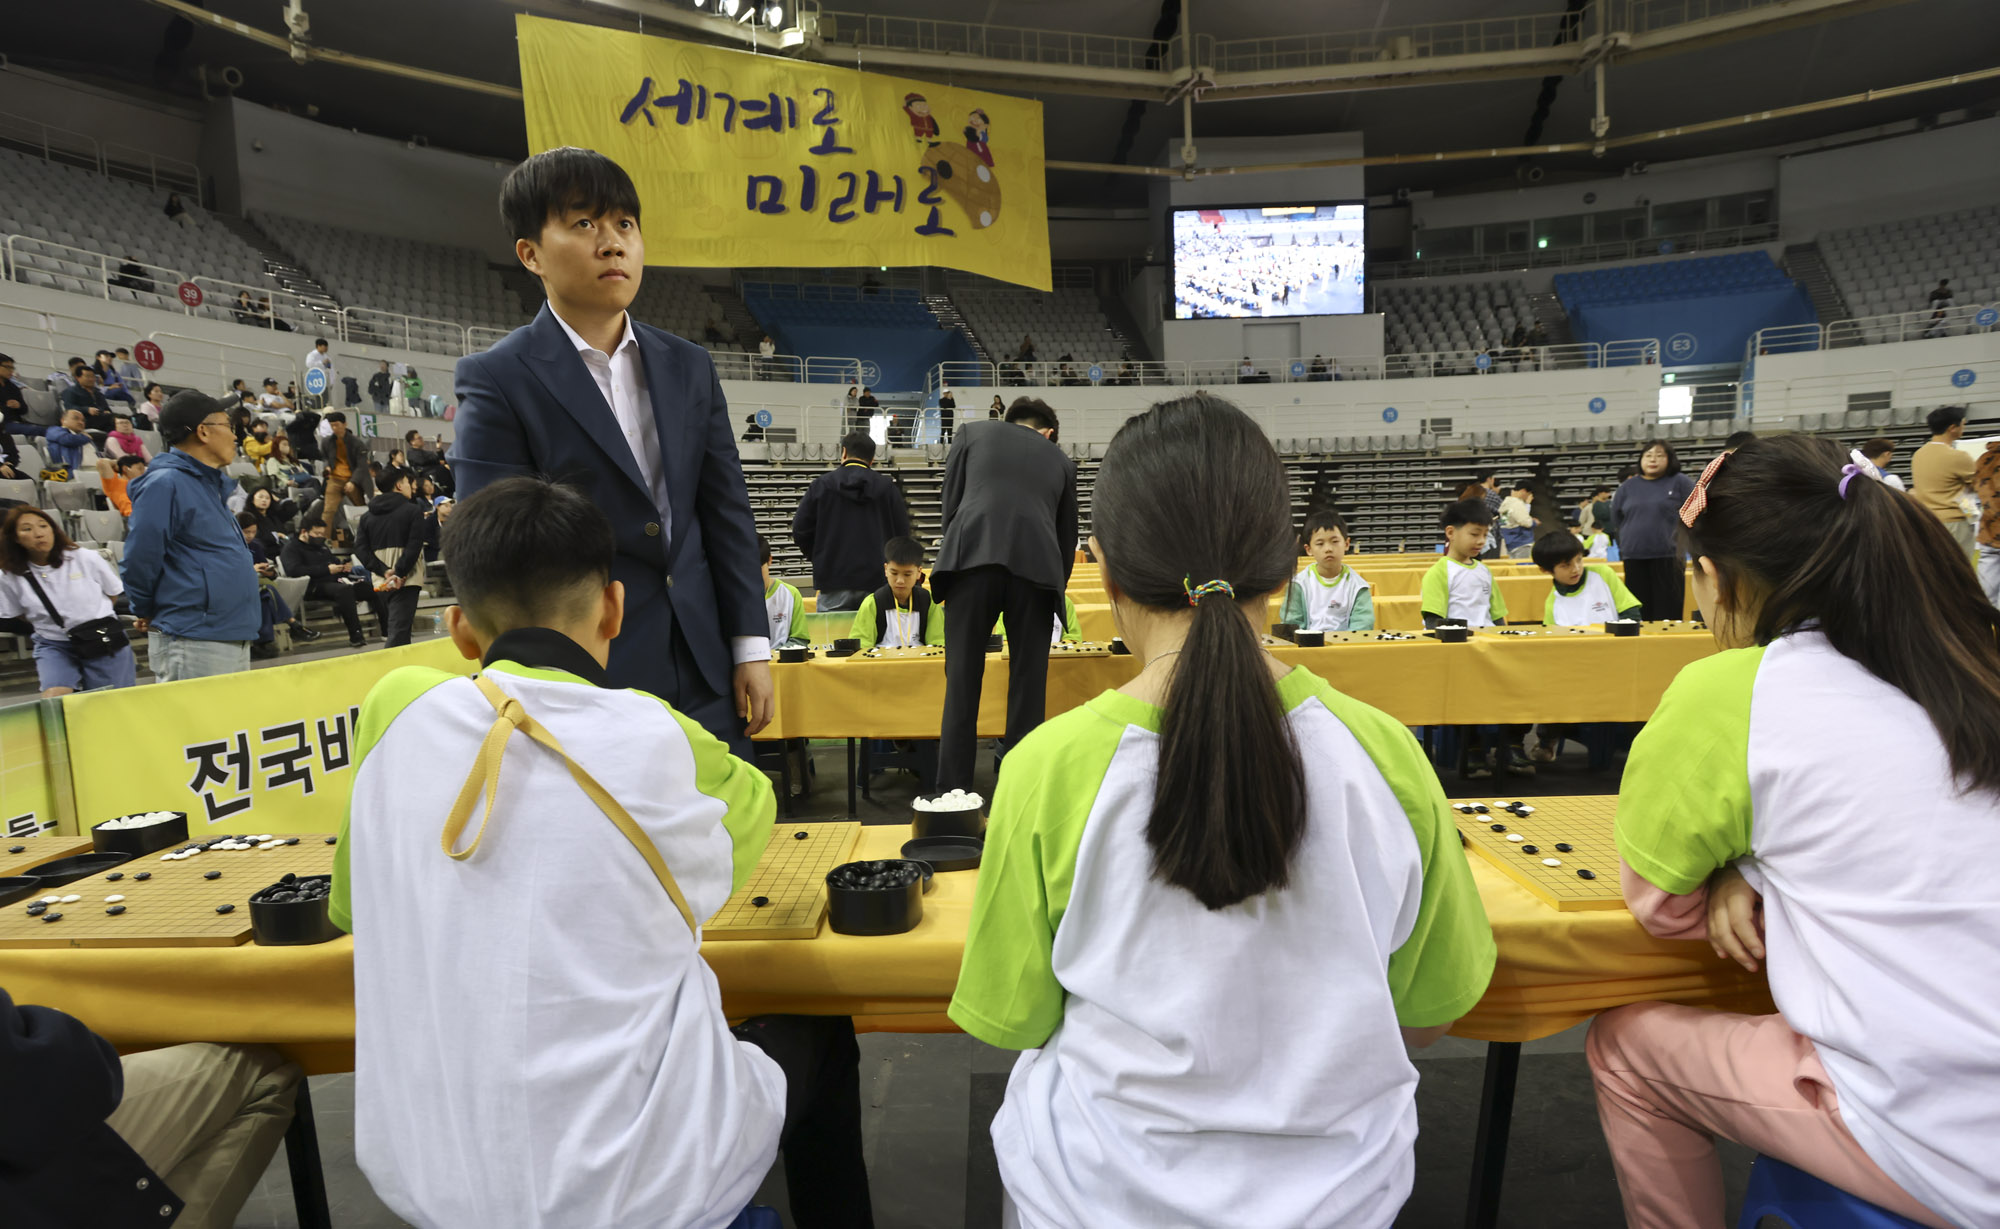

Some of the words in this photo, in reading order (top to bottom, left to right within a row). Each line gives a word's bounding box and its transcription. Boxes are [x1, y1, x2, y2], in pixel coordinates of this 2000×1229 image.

[621, 78, 852, 155] 세계로
[747, 165, 954, 237] 미래로
[183, 288, 198, 299] 39
[1672, 339, 1690, 351] E3
[143, 349, 155, 361] 11
[760, 414, 768, 422] 12
